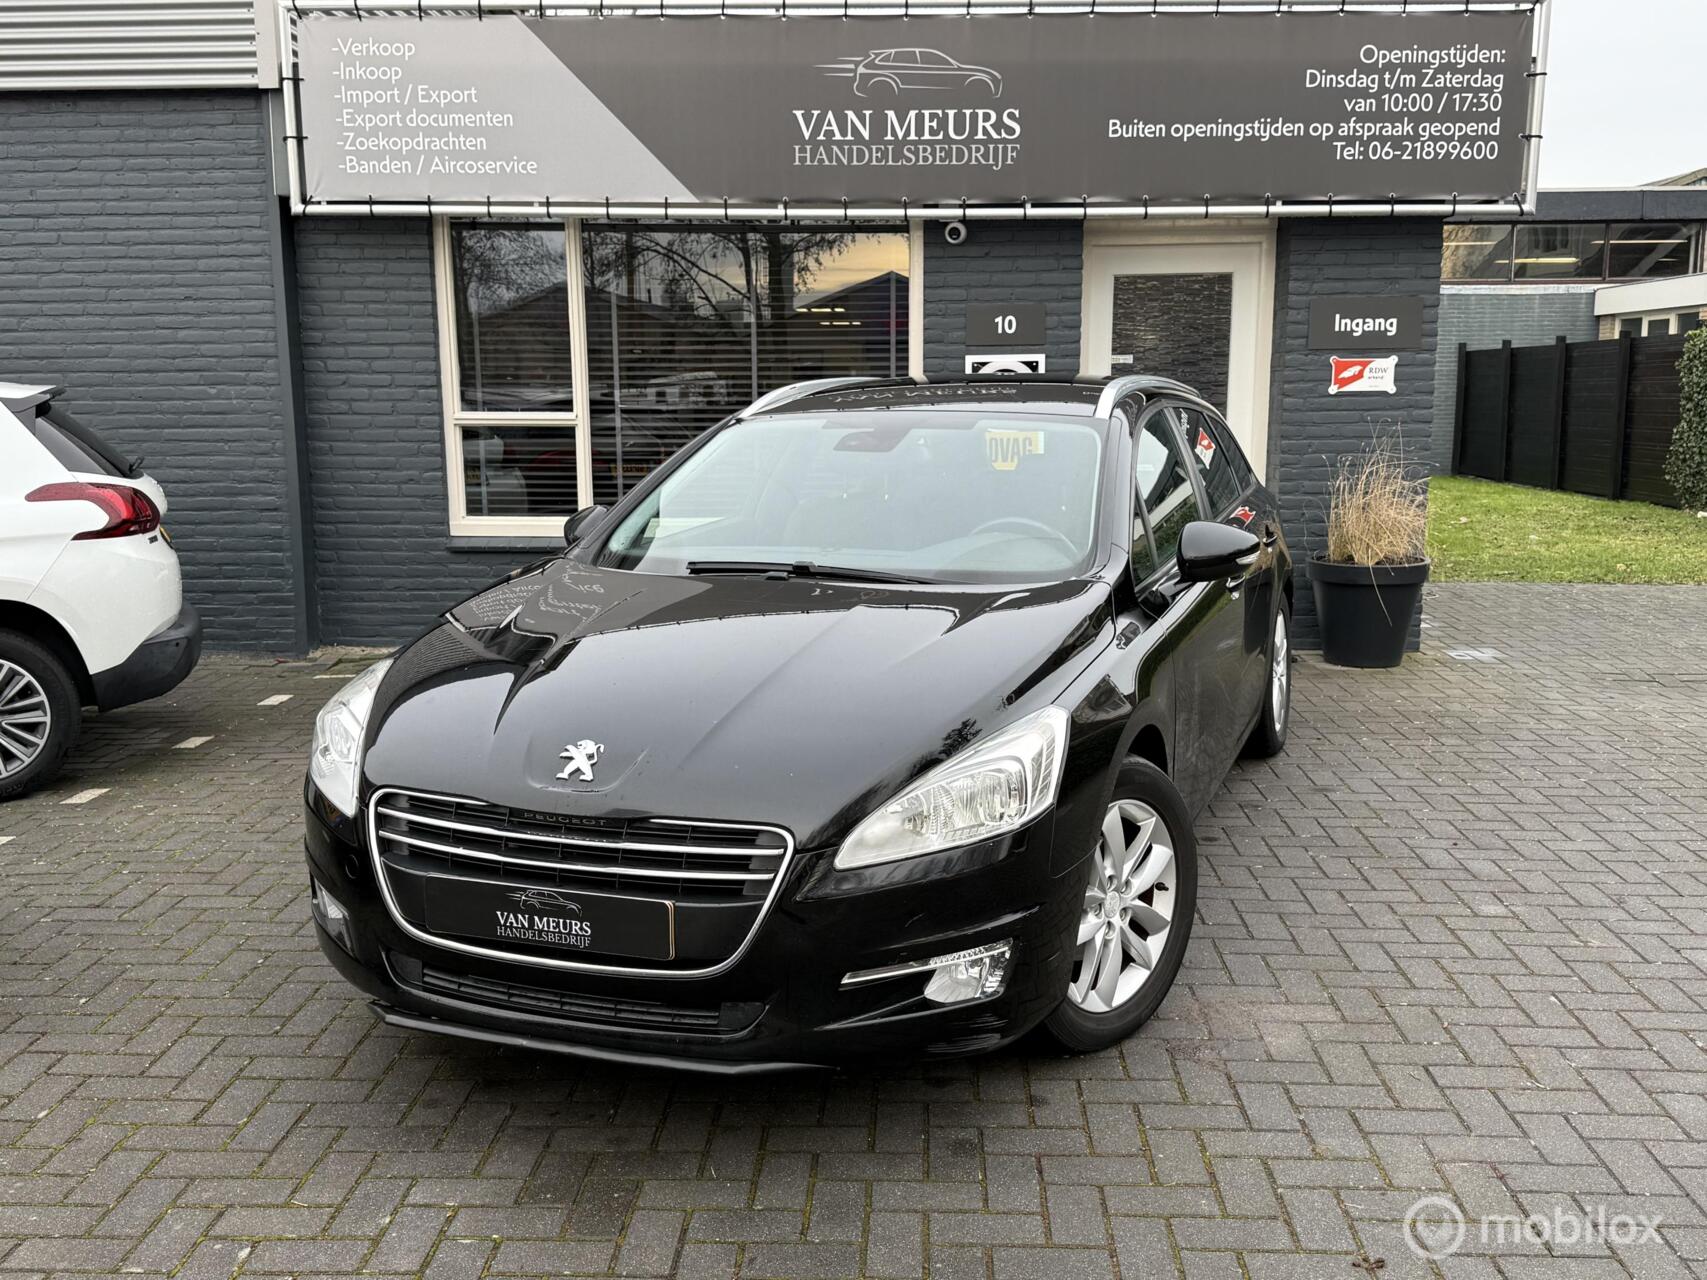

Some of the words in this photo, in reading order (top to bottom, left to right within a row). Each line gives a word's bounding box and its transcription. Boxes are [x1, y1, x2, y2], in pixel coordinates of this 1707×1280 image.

[331, 37, 416, 60] -Verkoop
[1359, 43, 1506, 67] Openingstijden:
[332, 61, 402, 83] -Inkoop
[1305, 68, 1379, 93] Dinsdag
[1383, 69, 1416, 89] t/m
[1421, 67, 1504, 92] Zaterdag
[334, 85, 401, 106] -Import
[404, 83, 413, 105] /
[417, 85, 478, 106] Export
[1343, 97, 1376, 112] van
[1381, 93, 1433, 113] 10:00
[1436, 93, 1447, 115] /
[1452, 92, 1502, 112] 17:30
[335, 108, 402, 130] -Export
[406, 107, 514, 127] documenten
[792, 109, 873, 141] VAN
[884, 108, 1022, 141] MEURS
[1108, 118, 1166, 138] Buiten
[1170, 120, 1305, 142] openingstijden
[1308, 122, 1334, 141] op
[1338, 118, 1414, 140] afspraak
[1418, 116, 1501, 141] geopend
[336, 132, 487, 154] -Zoekopdrachten
[1332, 140, 1364, 160] Tel:
[1368, 139, 1499, 160] 06-21899600
[338, 155, 412, 174] -Banden
[416, 154, 425, 176] /
[429, 155, 538, 175] Aircoservice
[793, 143, 1021, 171] HANDELSBEDRIJF
[994, 315, 1017, 334] 10
[1334, 313, 1398, 337] Ingang
[523, 812, 607, 826] PEUGEOT
[496, 910, 529, 928] VAN
[533, 915, 592, 936] MEURS
[496, 926, 592, 948] HANDELSBEDRIJF
